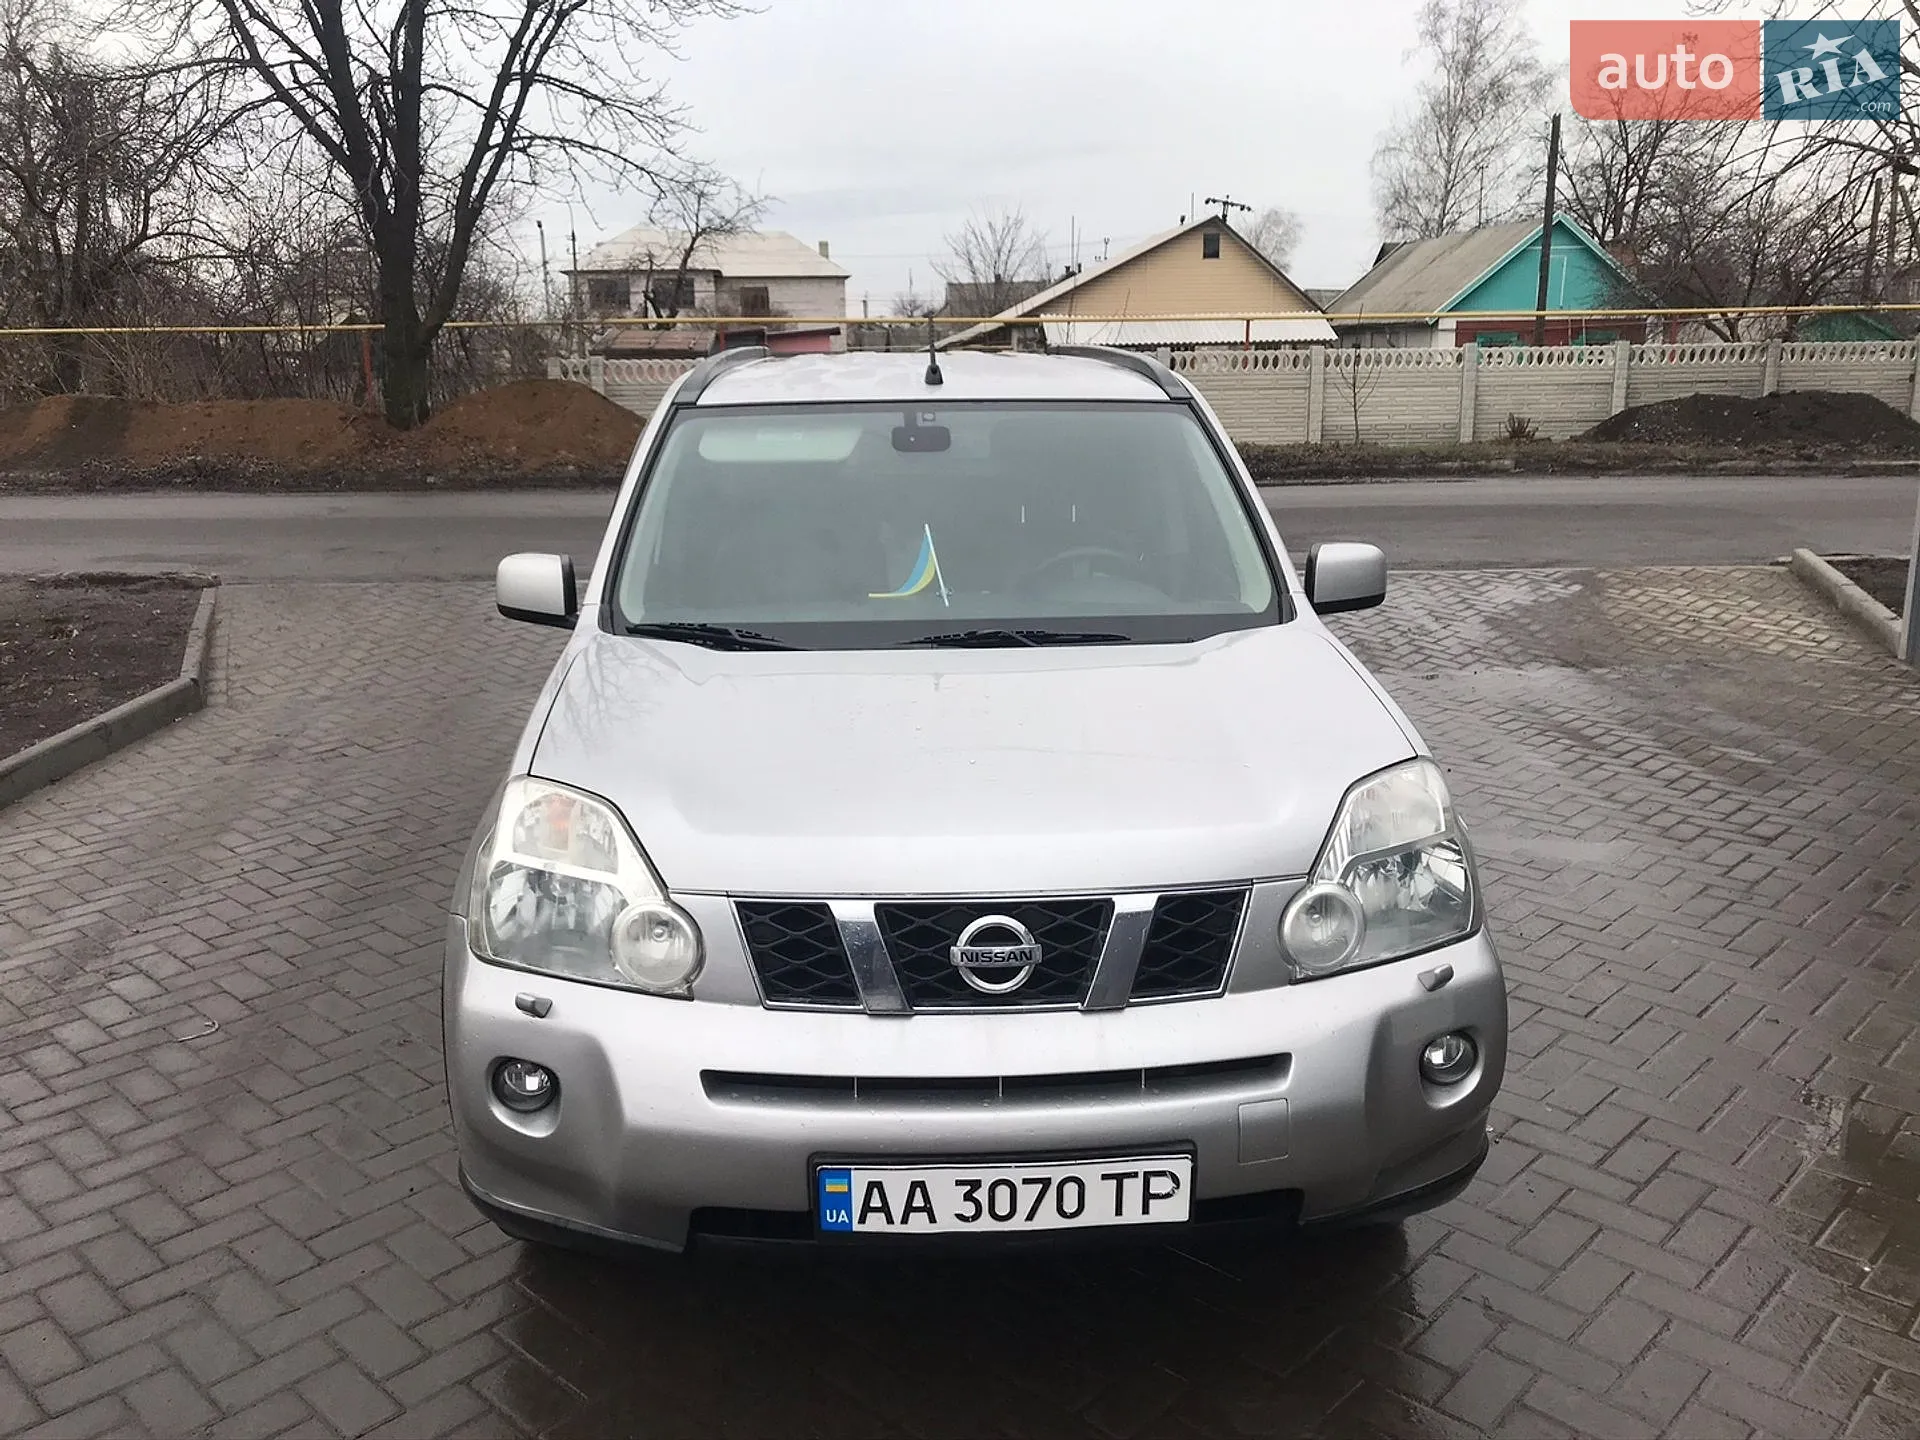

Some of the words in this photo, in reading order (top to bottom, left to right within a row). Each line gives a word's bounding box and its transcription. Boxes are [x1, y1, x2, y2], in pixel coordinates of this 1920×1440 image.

[960, 950, 1033, 963] NISSAN
[857, 1180, 938, 1225] AA
[954, 1176, 1086, 1223] 3070
[1100, 1170, 1181, 1217] TP
[825, 1210, 849, 1224] UA
